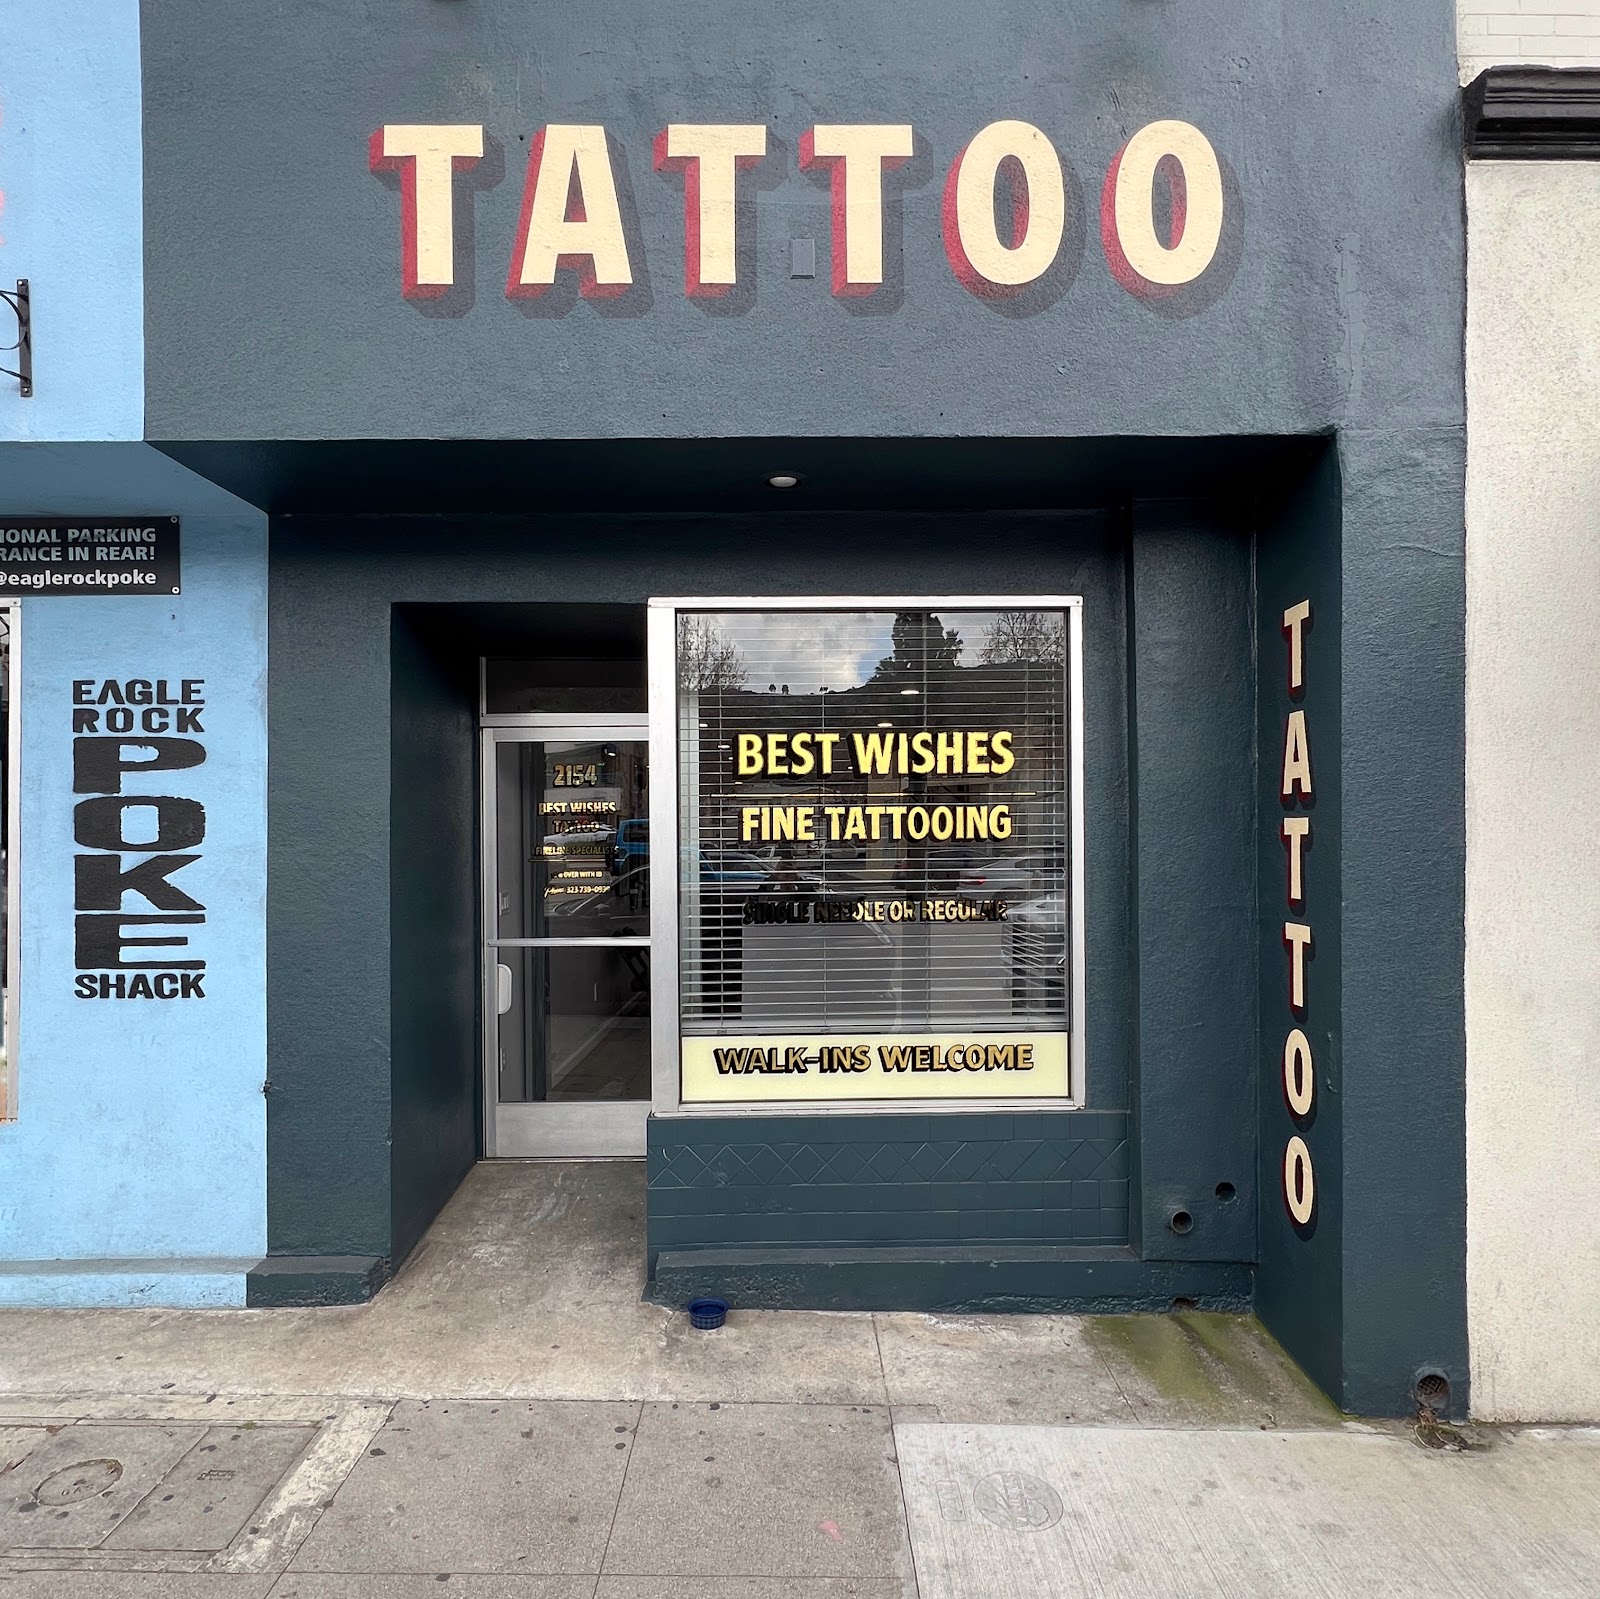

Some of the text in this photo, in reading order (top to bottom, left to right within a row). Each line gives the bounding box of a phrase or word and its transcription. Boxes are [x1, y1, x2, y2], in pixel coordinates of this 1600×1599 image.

[372, 119, 1226, 302] TATTOO
[67, 528, 156, 543] PARKING
[68, 547, 90, 561] IN
[95, 546, 155, 561] REAR!
[72, 679, 206, 705] EAGLE
[72, 707, 206, 733] ROCK
[733, 730, 1016, 779] BEST WISHES
[552, 763, 598, 787] 2154
[537, 800, 617, 816] BEST WISHES
[739, 804, 1013, 843] FINE TATTOOING
[72, 736, 207, 970] POKE
[563, 870, 579, 878] OVER
[579, 870, 596, 878] WITH
[813, 899, 887, 925] NEEDLE
[889, 899, 919, 924] OR
[920, 898, 1009, 924] REGULAR
[1281, 599, 1319, 1232] TATTOO
[74, 973, 207, 999] SHACK
[712, 1043, 1035, 1075] WALK-INS WELCOME
